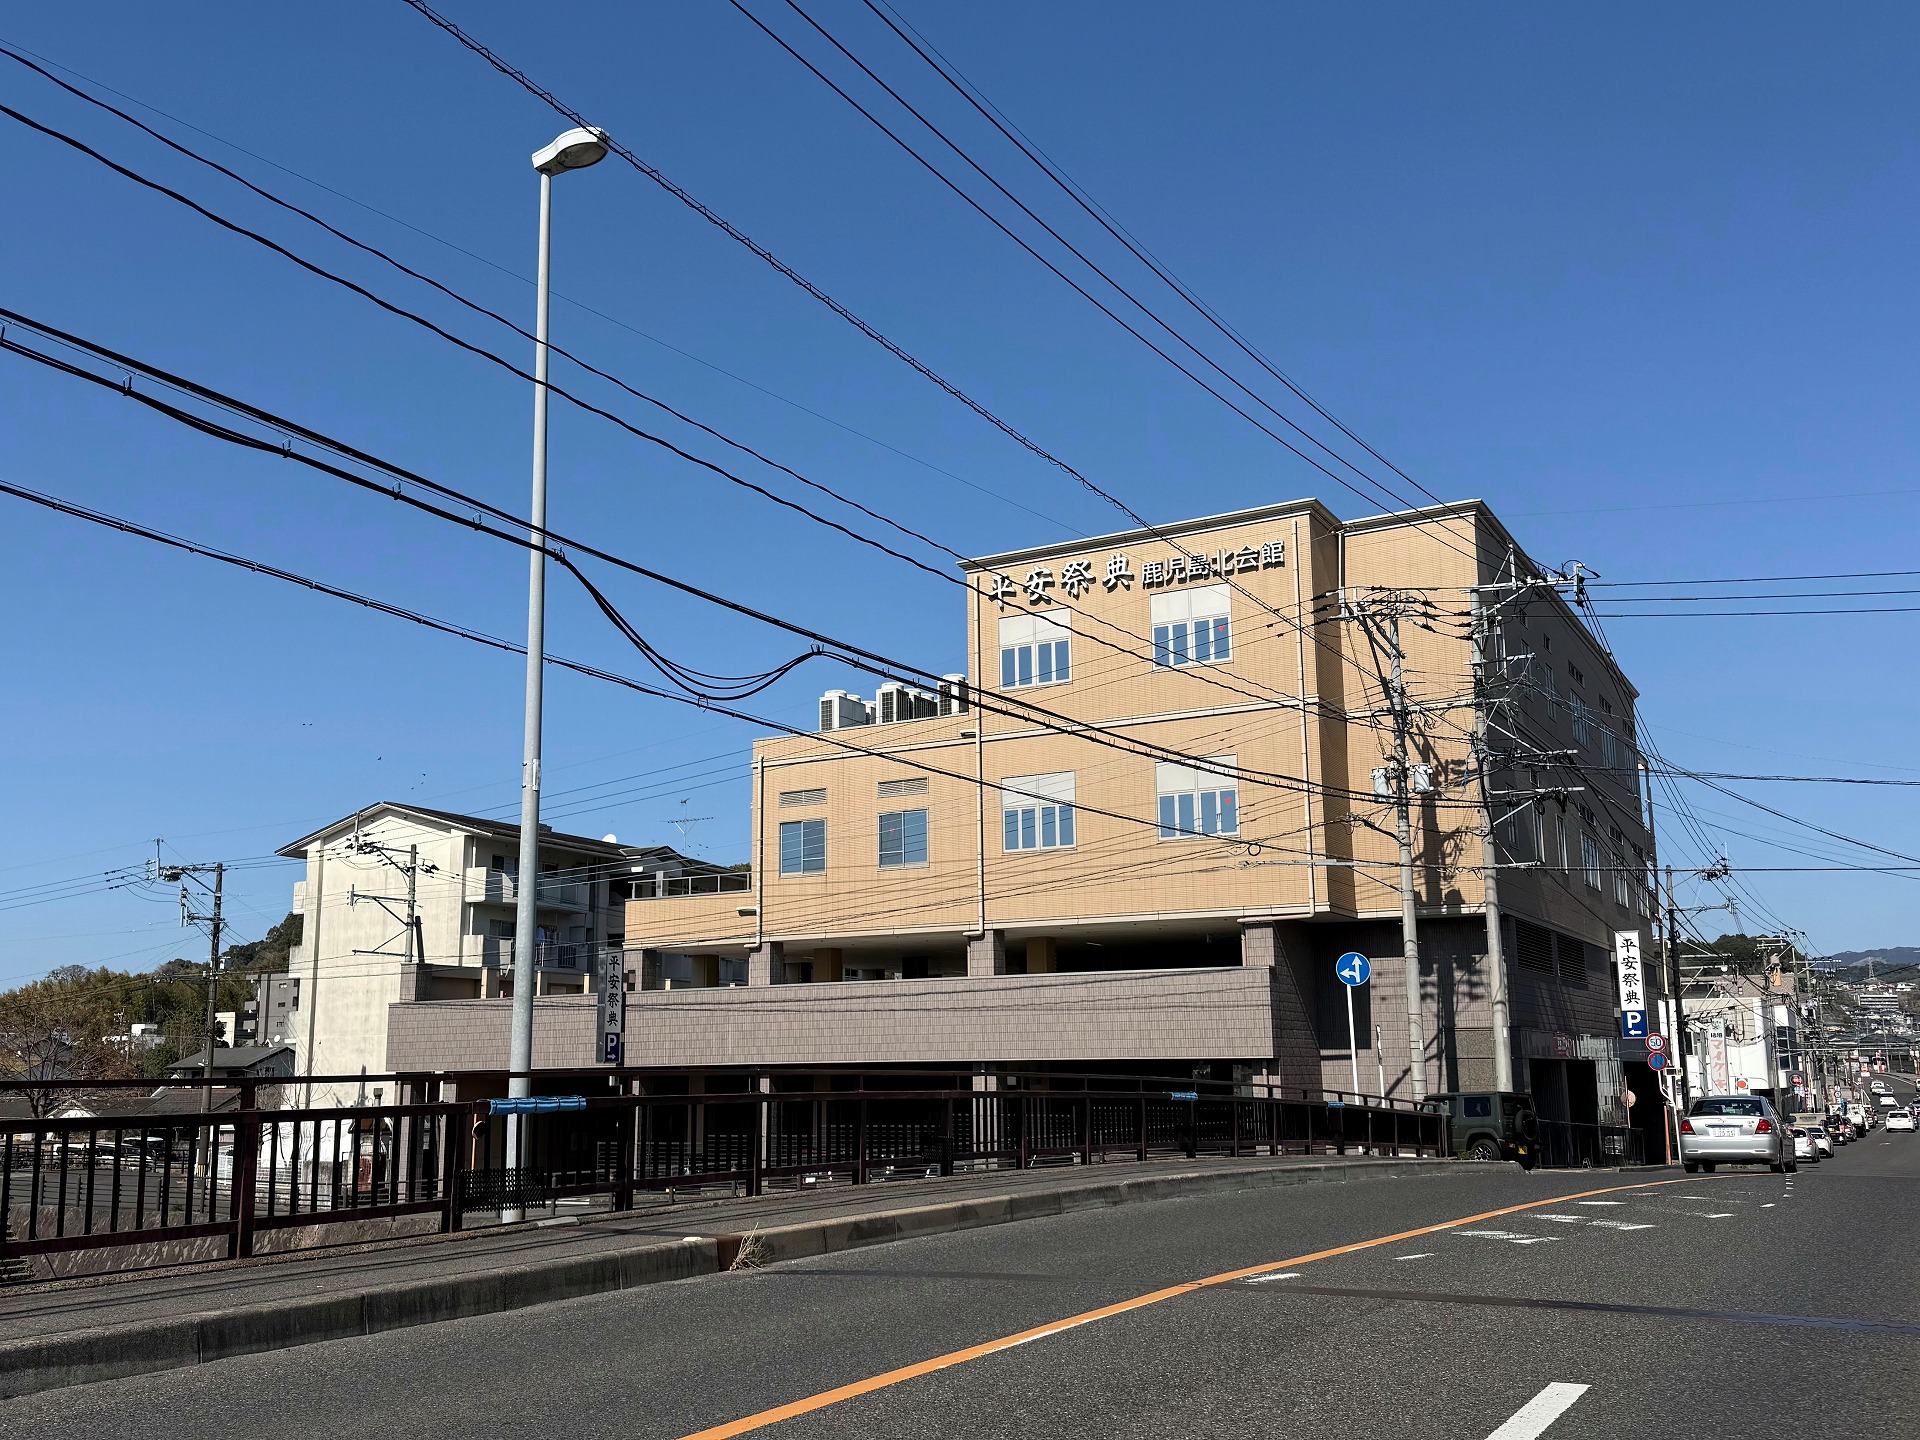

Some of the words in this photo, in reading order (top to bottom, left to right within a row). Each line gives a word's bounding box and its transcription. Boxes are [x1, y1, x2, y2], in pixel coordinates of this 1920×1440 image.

[987, 553, 1133, 611] 平安祭典
[1141, 540, 1285, 588] 鹿児島北会館
[607, 955, 621, 1027] 平安祭典
[1619, 938, 1641, 1005] 平安祭典
[1626, 1011, 1642, 1029] P
[607, 1034, 617, 1052] P
[1650, 1038, 1662, 1047] 50
